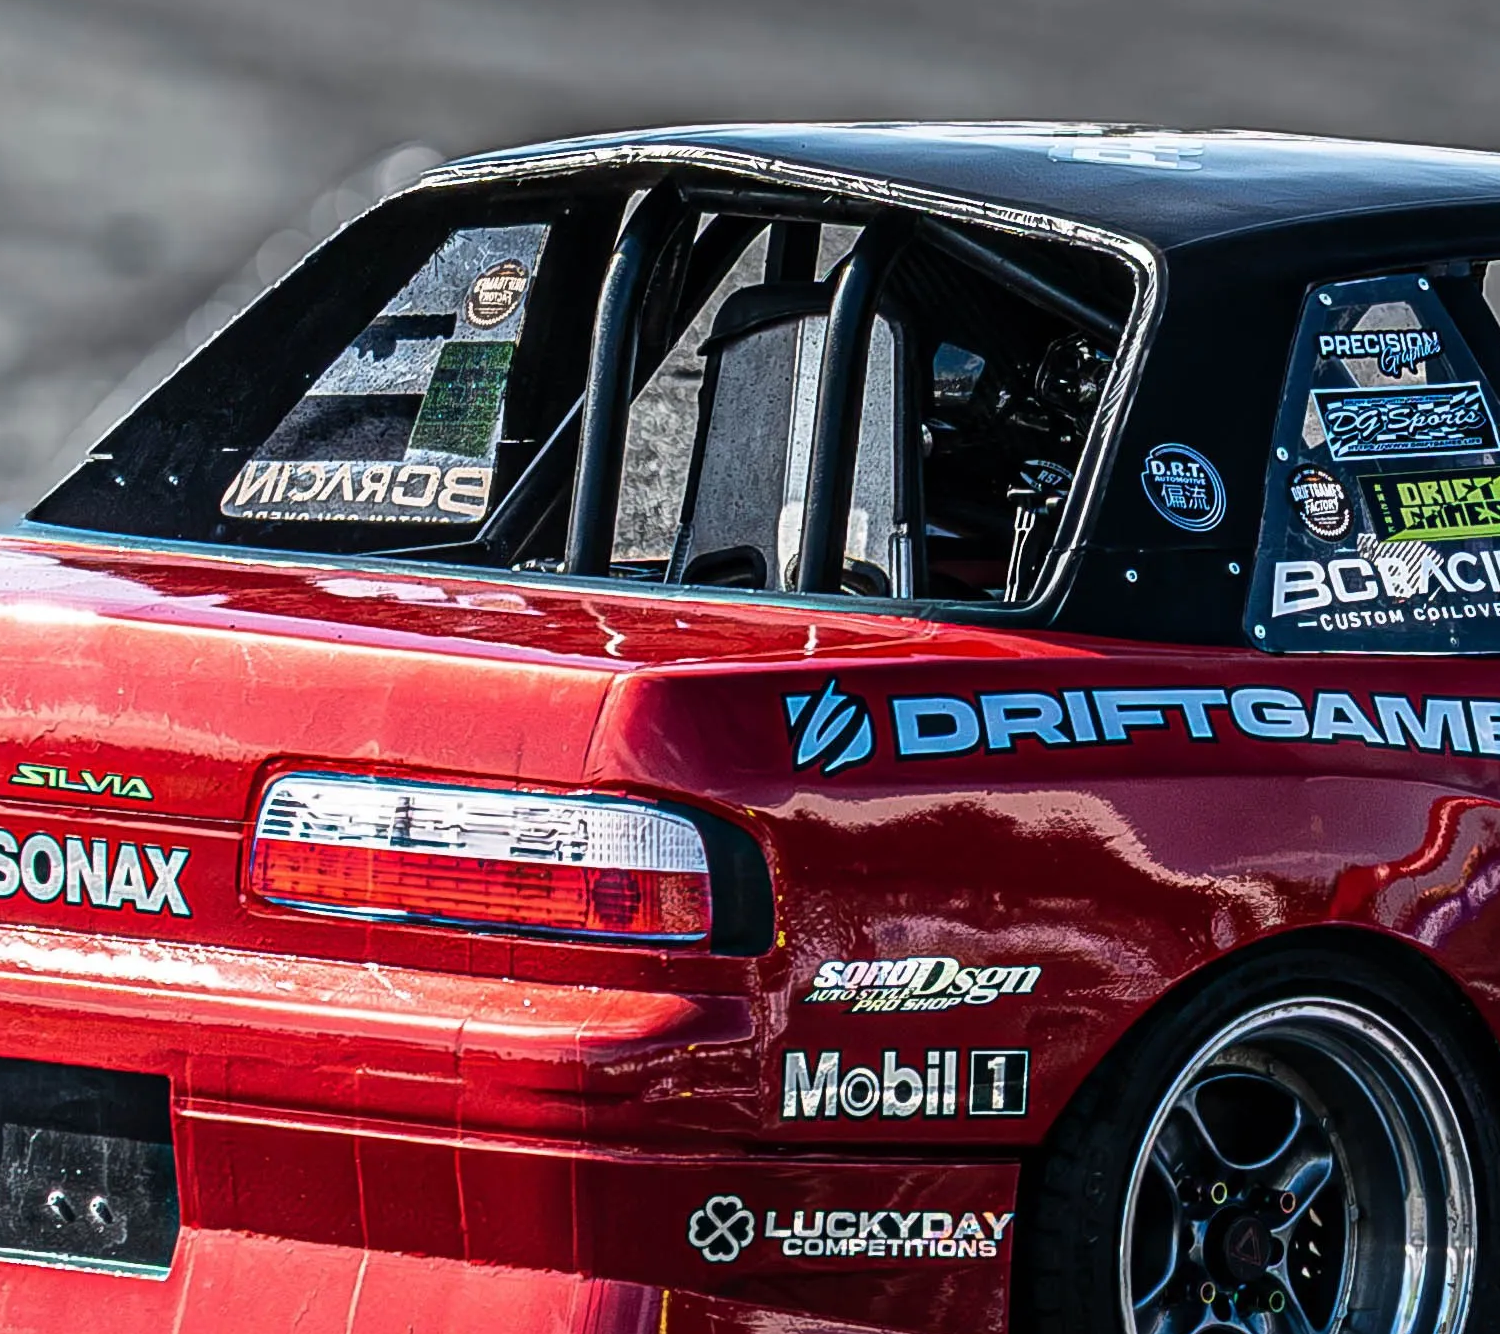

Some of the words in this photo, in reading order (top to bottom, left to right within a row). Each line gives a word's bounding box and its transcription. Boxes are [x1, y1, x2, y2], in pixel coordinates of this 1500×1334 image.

[1320, 332, 1438, 355] PRECISION
[1328, 409, 1381, 437] DG
[1388, 408, 1479, 433] Sports
[1151, 461, 1204, 477] D.R.T.
[1155, 476, 1206, 485] AUTOMOTIVE
[1397, 477, 1494, 505] DRIFT
[1304, 497, 1338, 515] FACTORY
[1321, 610, 1404, 631] CUSTOM
[11, 763, 153, 799] SILVIA
[804, 989, 856, 1002] AUTO
[857, 987, 916, 1000] STYLE
[852, 1000, 901, 1013] PRO
[901, 997, 963, 1010] SHOP
[783, 1051, 957, 1117] Mobil
[766, 1210, 1015, 1240] LUCKYDAY
[782, 1238, 998, 1258] COMPETITIONS
